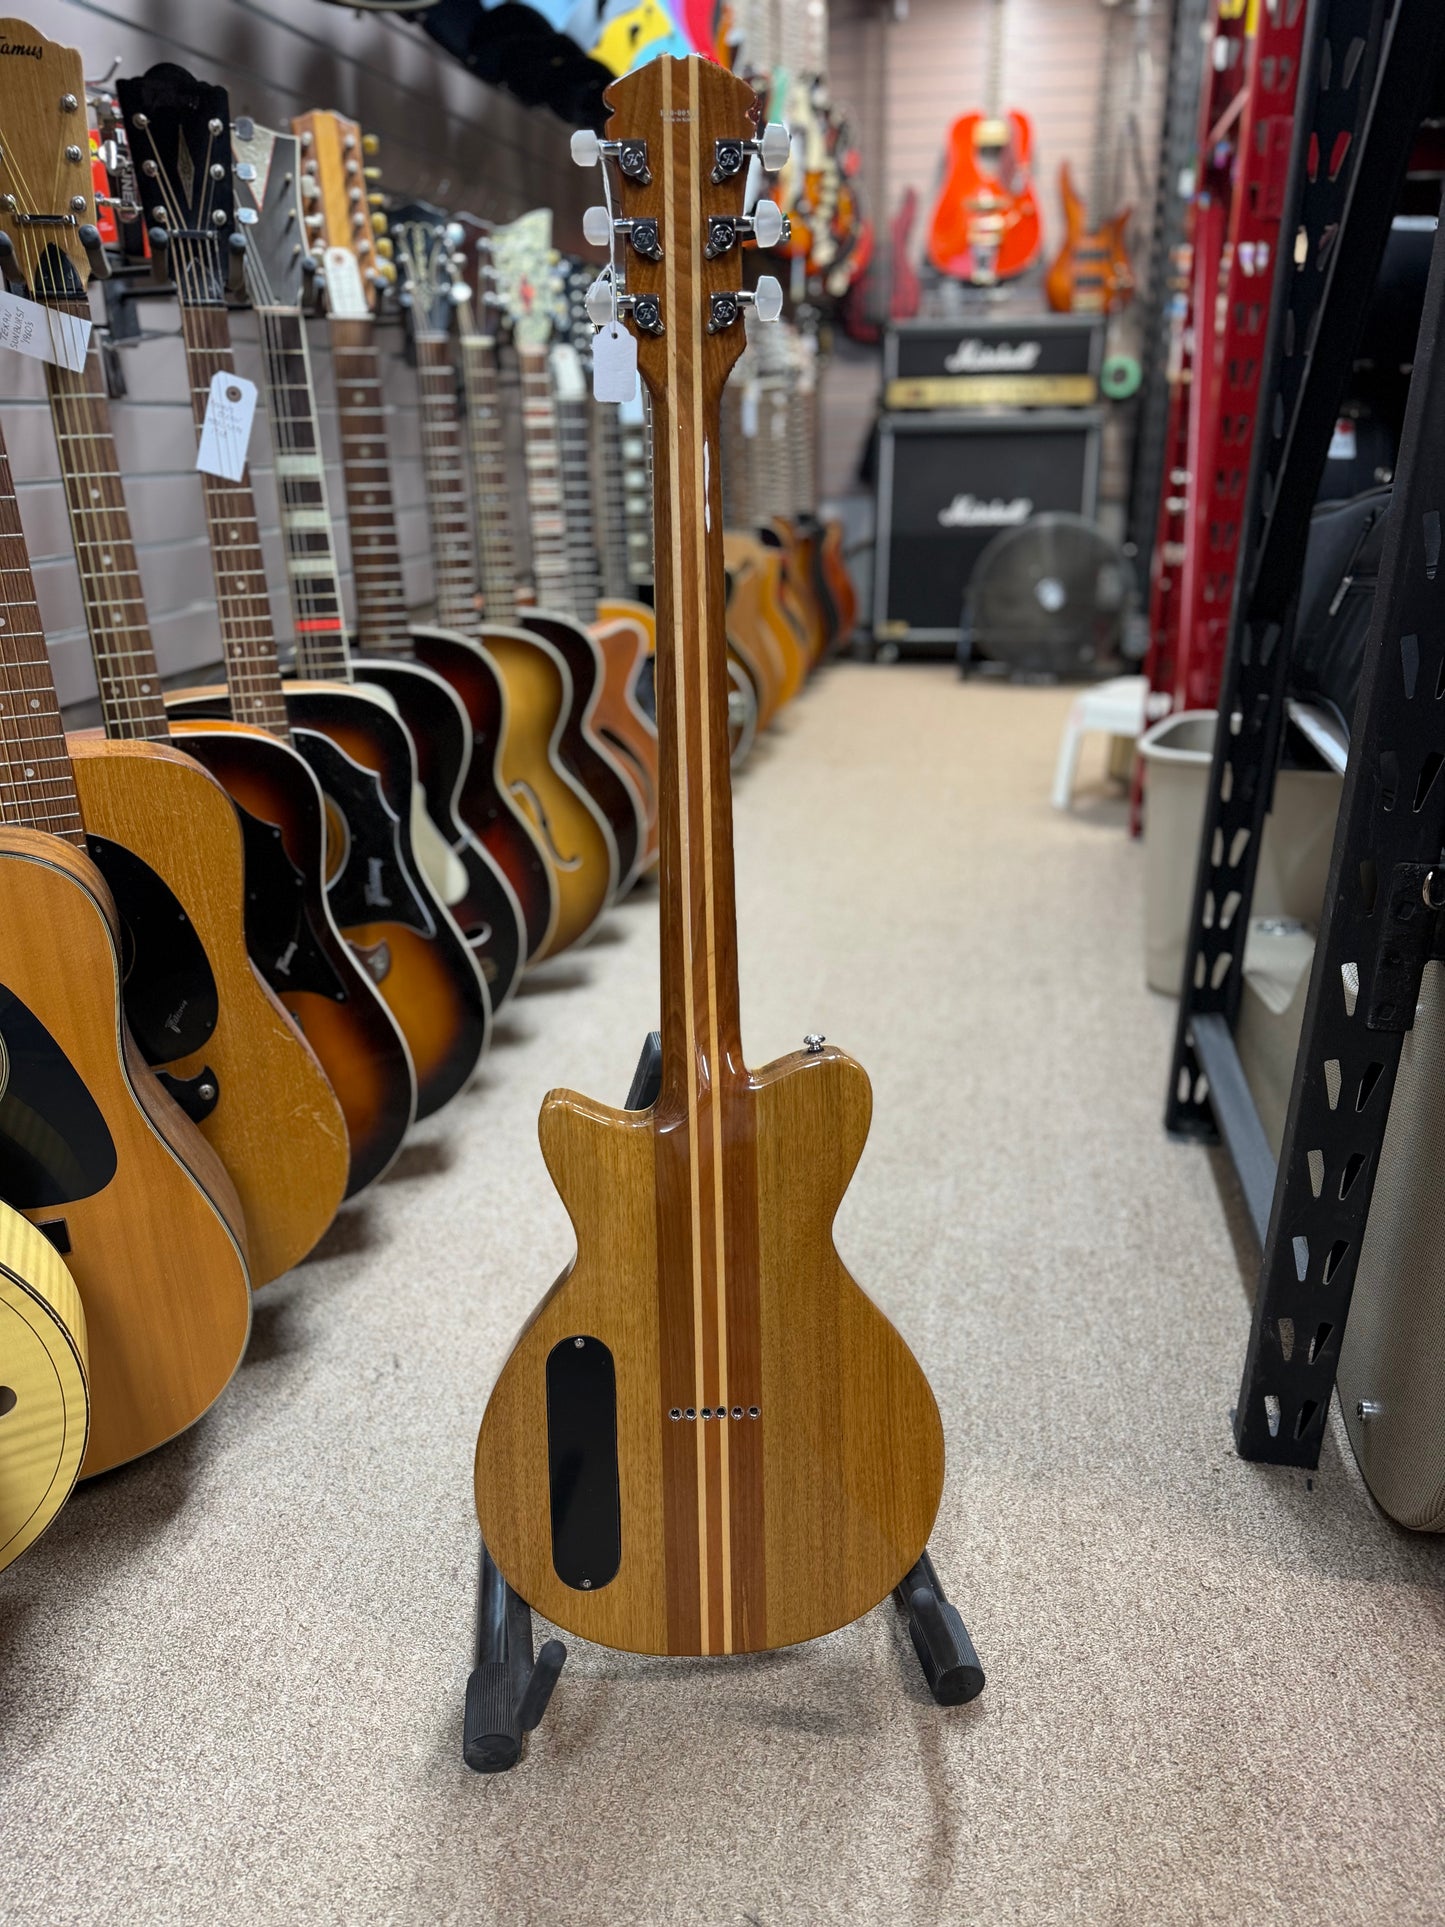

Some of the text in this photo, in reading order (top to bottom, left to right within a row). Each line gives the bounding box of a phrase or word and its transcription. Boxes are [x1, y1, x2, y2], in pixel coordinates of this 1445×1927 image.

[0, 36, 43, 60] amus
[0, 308, 13, 341] TEXAN
[10, 306, 25, 350] SUNBURST
